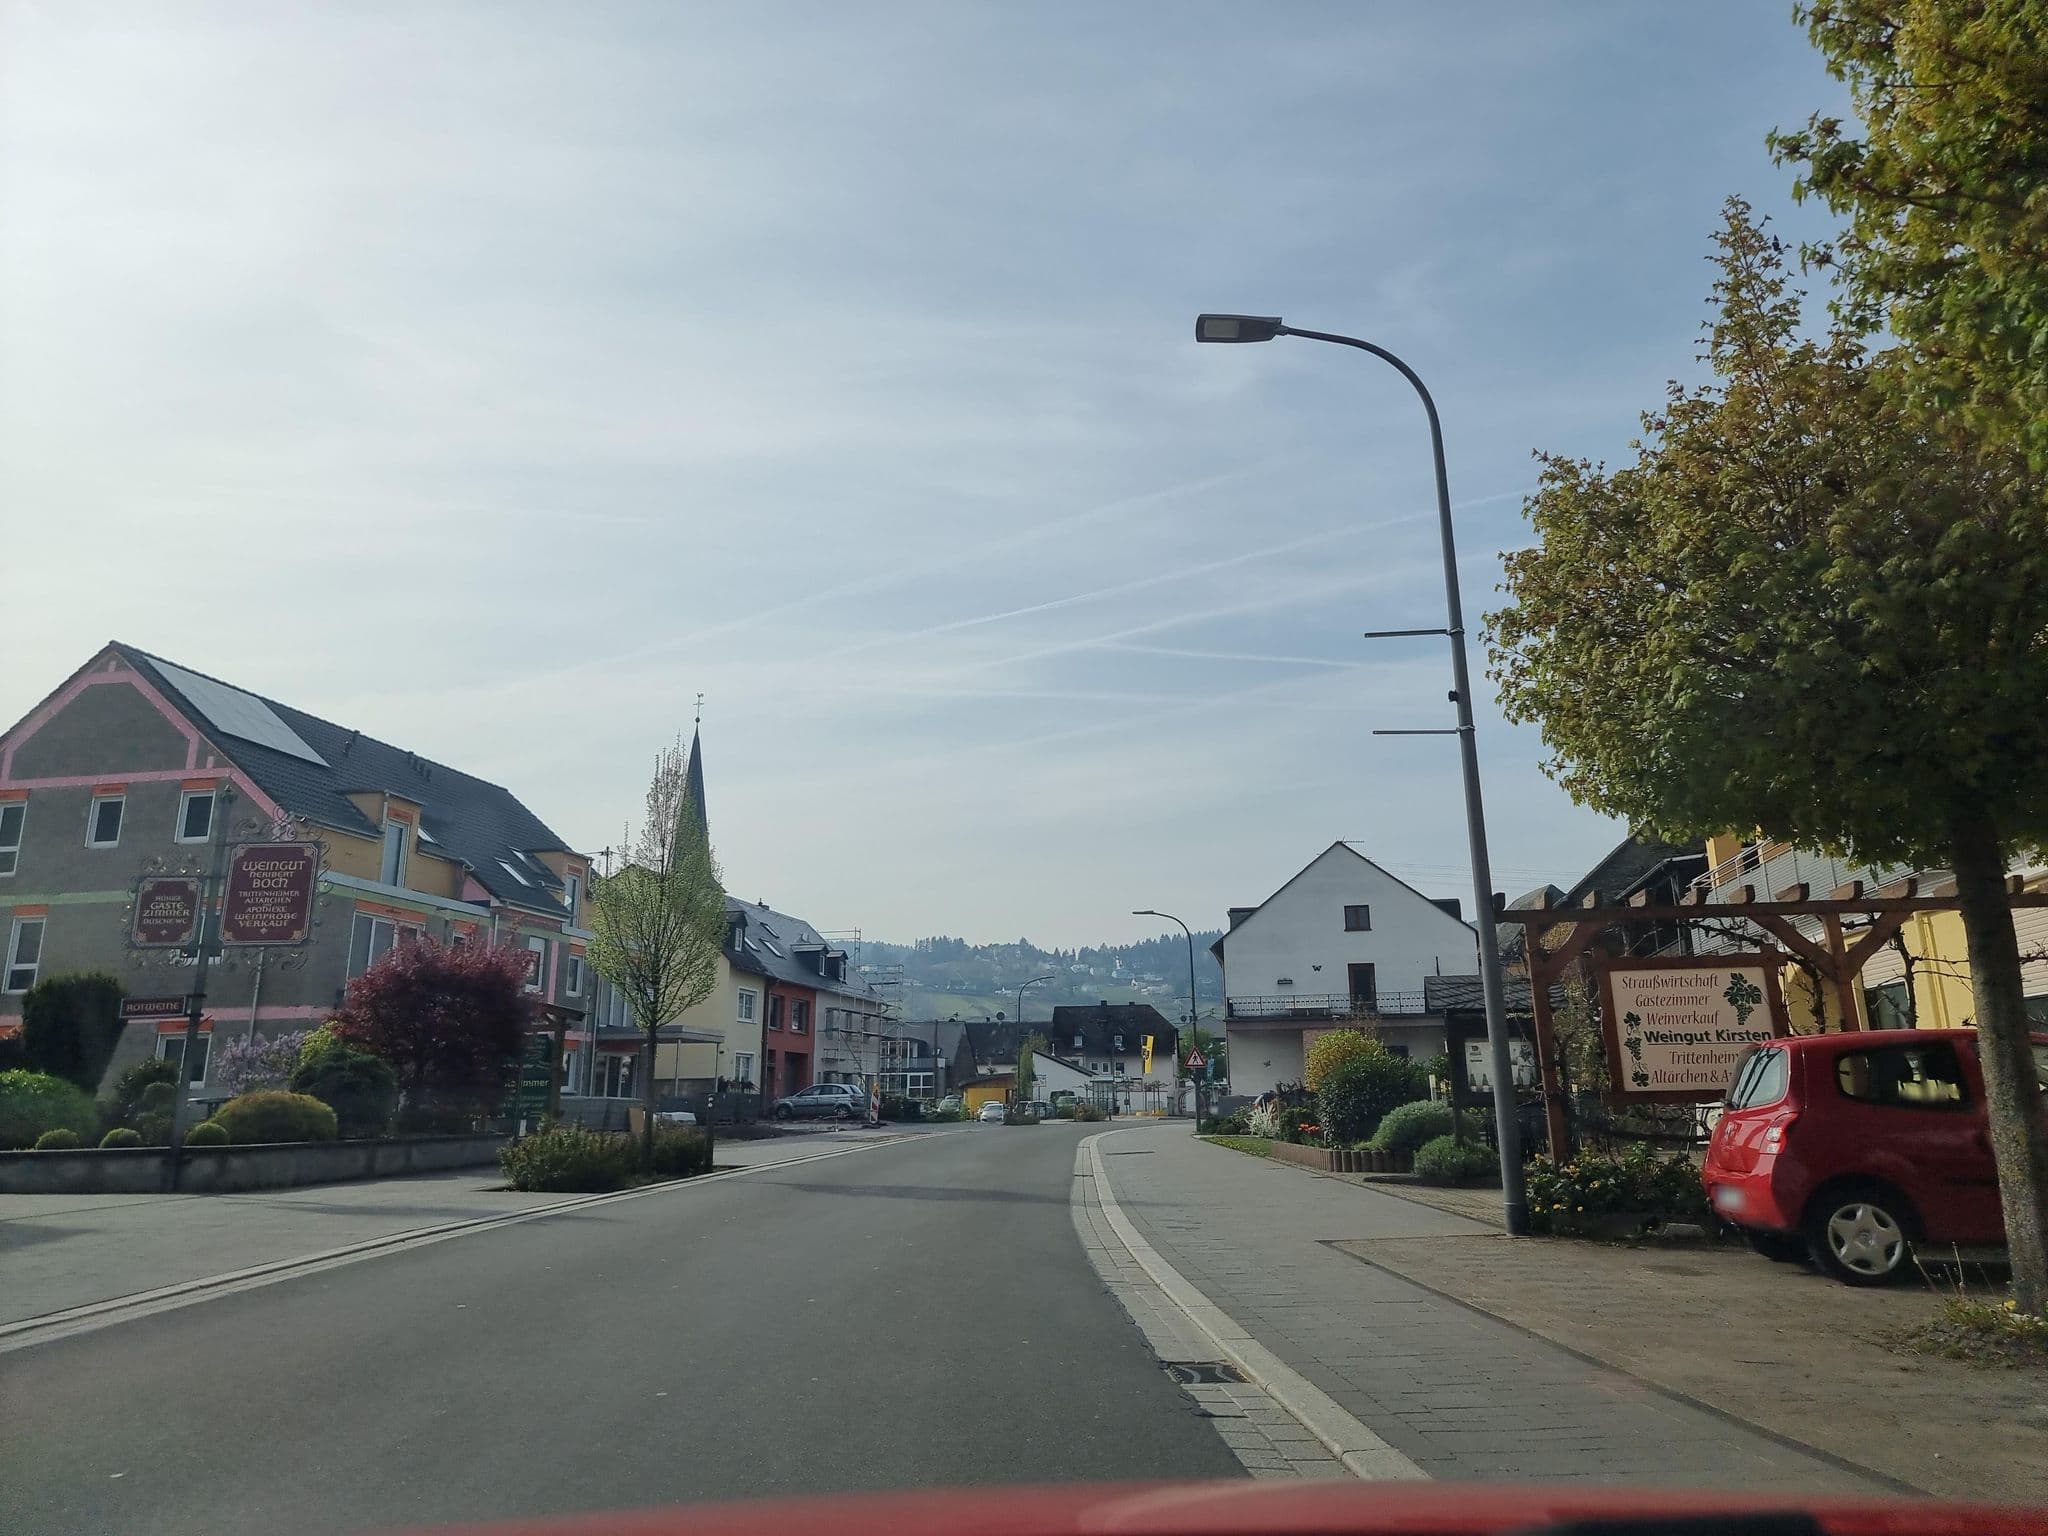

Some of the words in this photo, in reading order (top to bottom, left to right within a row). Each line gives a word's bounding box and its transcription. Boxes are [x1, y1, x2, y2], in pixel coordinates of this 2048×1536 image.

[242, 861, 306, 871] WEINGUT
[143, 909, 190, 917] ZIMMER
[234, 912, 298, 920] WEINPROBE
[1622, 973, 1720, 990] Straußwirtschaft
[1646, 1011, 1719, 1026] Weinverkauf
[1643, 1030, 1711, 1046] Weingut
[1716, 1029, 1772, 1042] Kirsten
[1710, 1070, 1720, 1083] &
